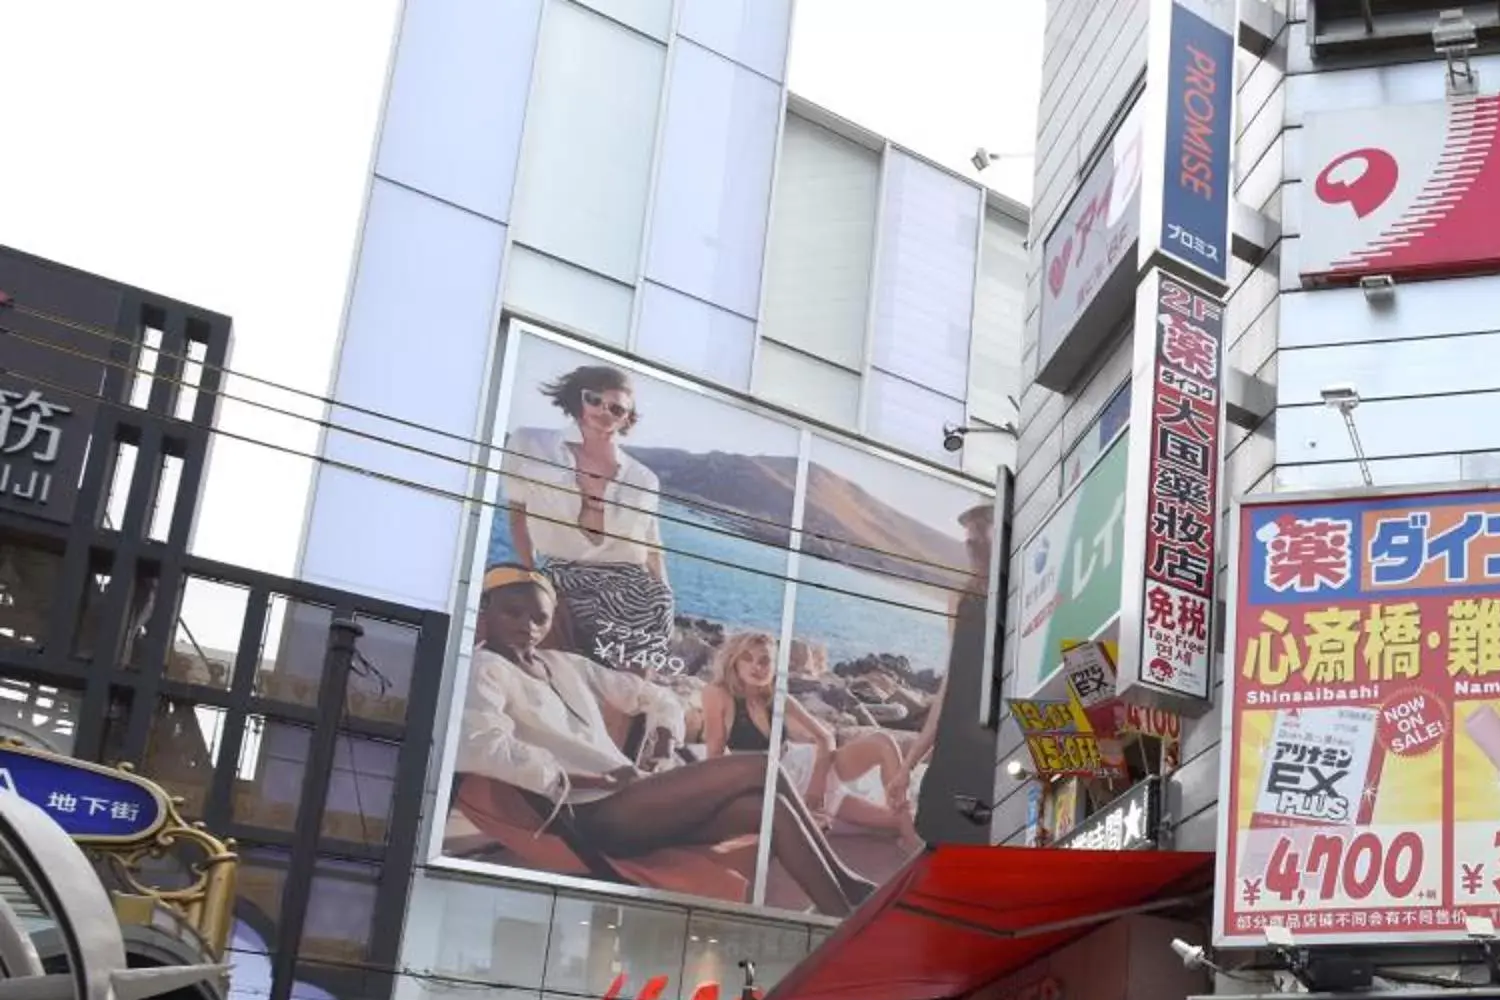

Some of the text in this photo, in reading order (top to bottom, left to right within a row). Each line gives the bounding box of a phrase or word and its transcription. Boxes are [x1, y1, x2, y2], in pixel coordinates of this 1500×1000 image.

[1180, 44, 1217, 200] PROMISE
[1167, 222, 1220, 262] プロミス
[1160, 279, 1220, 322] 2F
[1160, 312, 1219, 380] 薬
[0, 390, 72, 462] 筋
[1260, 514, 1353, 593] 薬
[1147, 585, 1207, 642] 免税
[593, 637, 686, 677] ¥1,499
[1246, 684, 1380, 705] Shinsaibashi
[1385, 695, 1426, 725] NOW
[1391, 720, 1444, 753] SALE!
[1396, 713, 1425, 734] ON
[1275, 741, 1353, 769] アリナミン
[1266, 761, 1350, 798] EX
[47, 791, 141, 822] 地下街
[1275, 789, 1350, 821] PLUS
